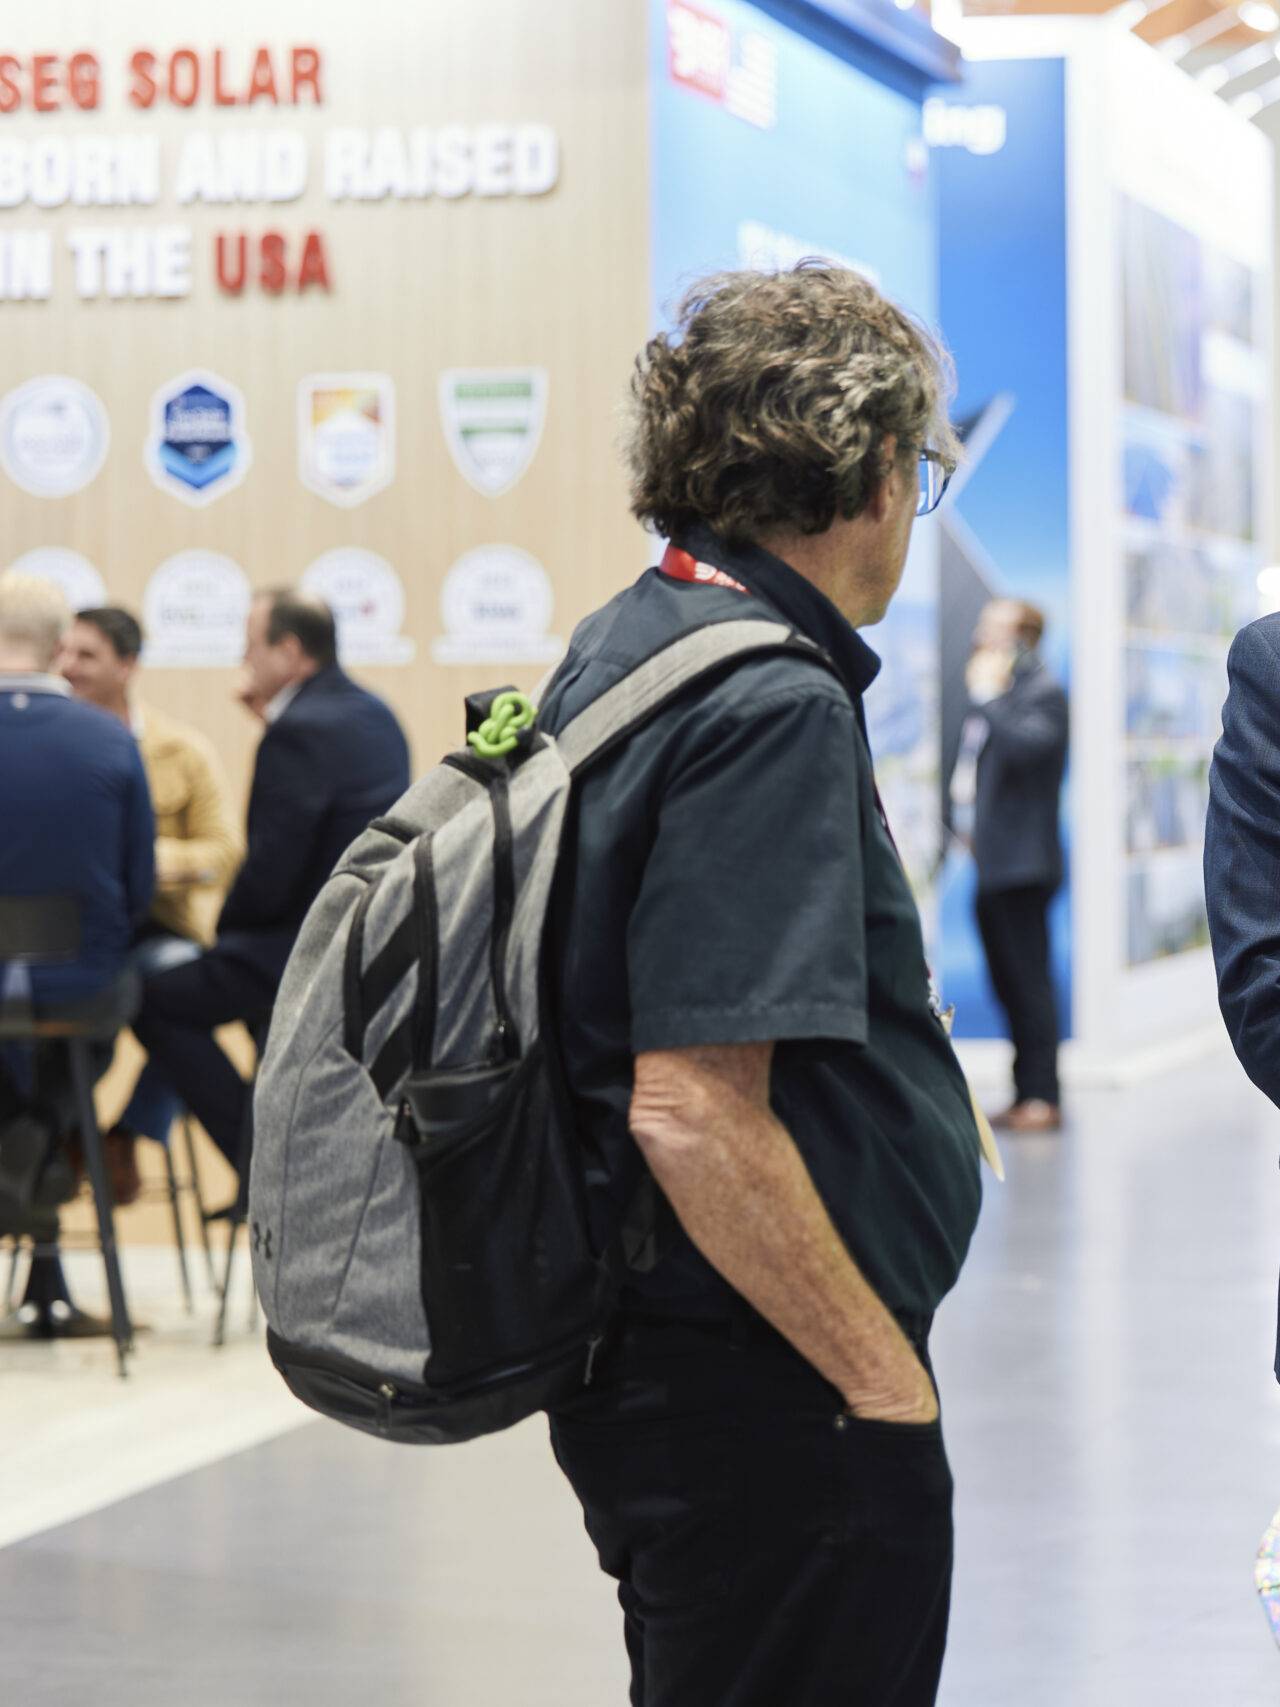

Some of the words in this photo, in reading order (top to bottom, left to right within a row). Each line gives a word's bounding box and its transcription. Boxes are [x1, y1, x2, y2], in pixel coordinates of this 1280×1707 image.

[0, 53, 99, 114] SEG
[129, 47, 324, 109] SOLAR
[0, 132, 161, 208] BORN
[177, 128, 308, 204] AND
[325, 123, 560, 200] RAISED
[66, 227, 192, 299] THE
[214, 231, 332, 296] USA
